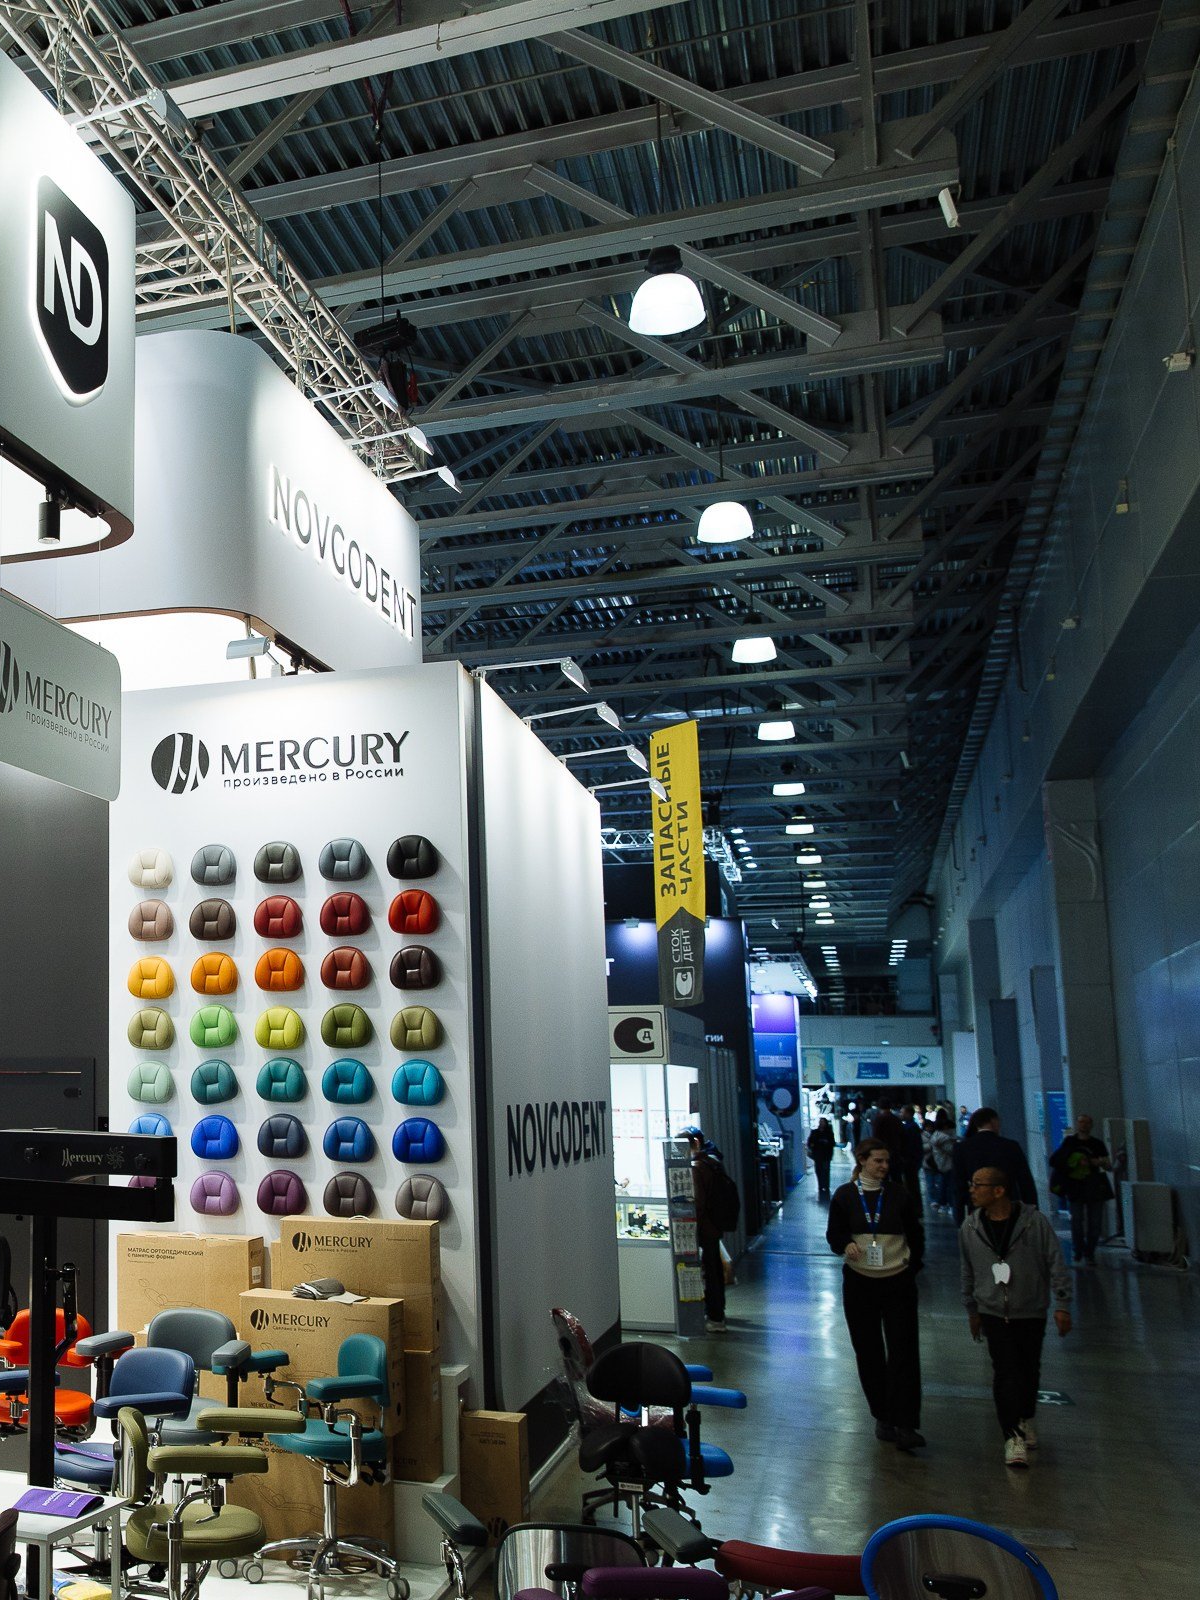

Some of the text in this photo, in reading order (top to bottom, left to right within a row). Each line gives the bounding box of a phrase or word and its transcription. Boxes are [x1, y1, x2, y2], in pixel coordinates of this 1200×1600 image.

[273, 464, 417, 638] NOVGODENT
[25, 670, 112, 739] MERCURY
[26, 710, 78, 740] произведено
[84, 733, 110, 753] России
[221, 730, 410, 775] MERCURY
[223, 767, 404, 790] произведено в России
[677, 801, 693, 895] ЧАСТИ
[670, 928, 681, 963] СТОК
[682, 928, 694, 962] ДЕНТ
[506, 1100, 606, 1177] NOVGODENT
[61, 1148, 104, 1167] Mercury
[150, 1248, 204, 1257] ОРТОПЕДИЧЕСКИЙ
[314, 1235, 374, 1248] MERCURY
[272, 1312, 331, 1328] MERCURY
